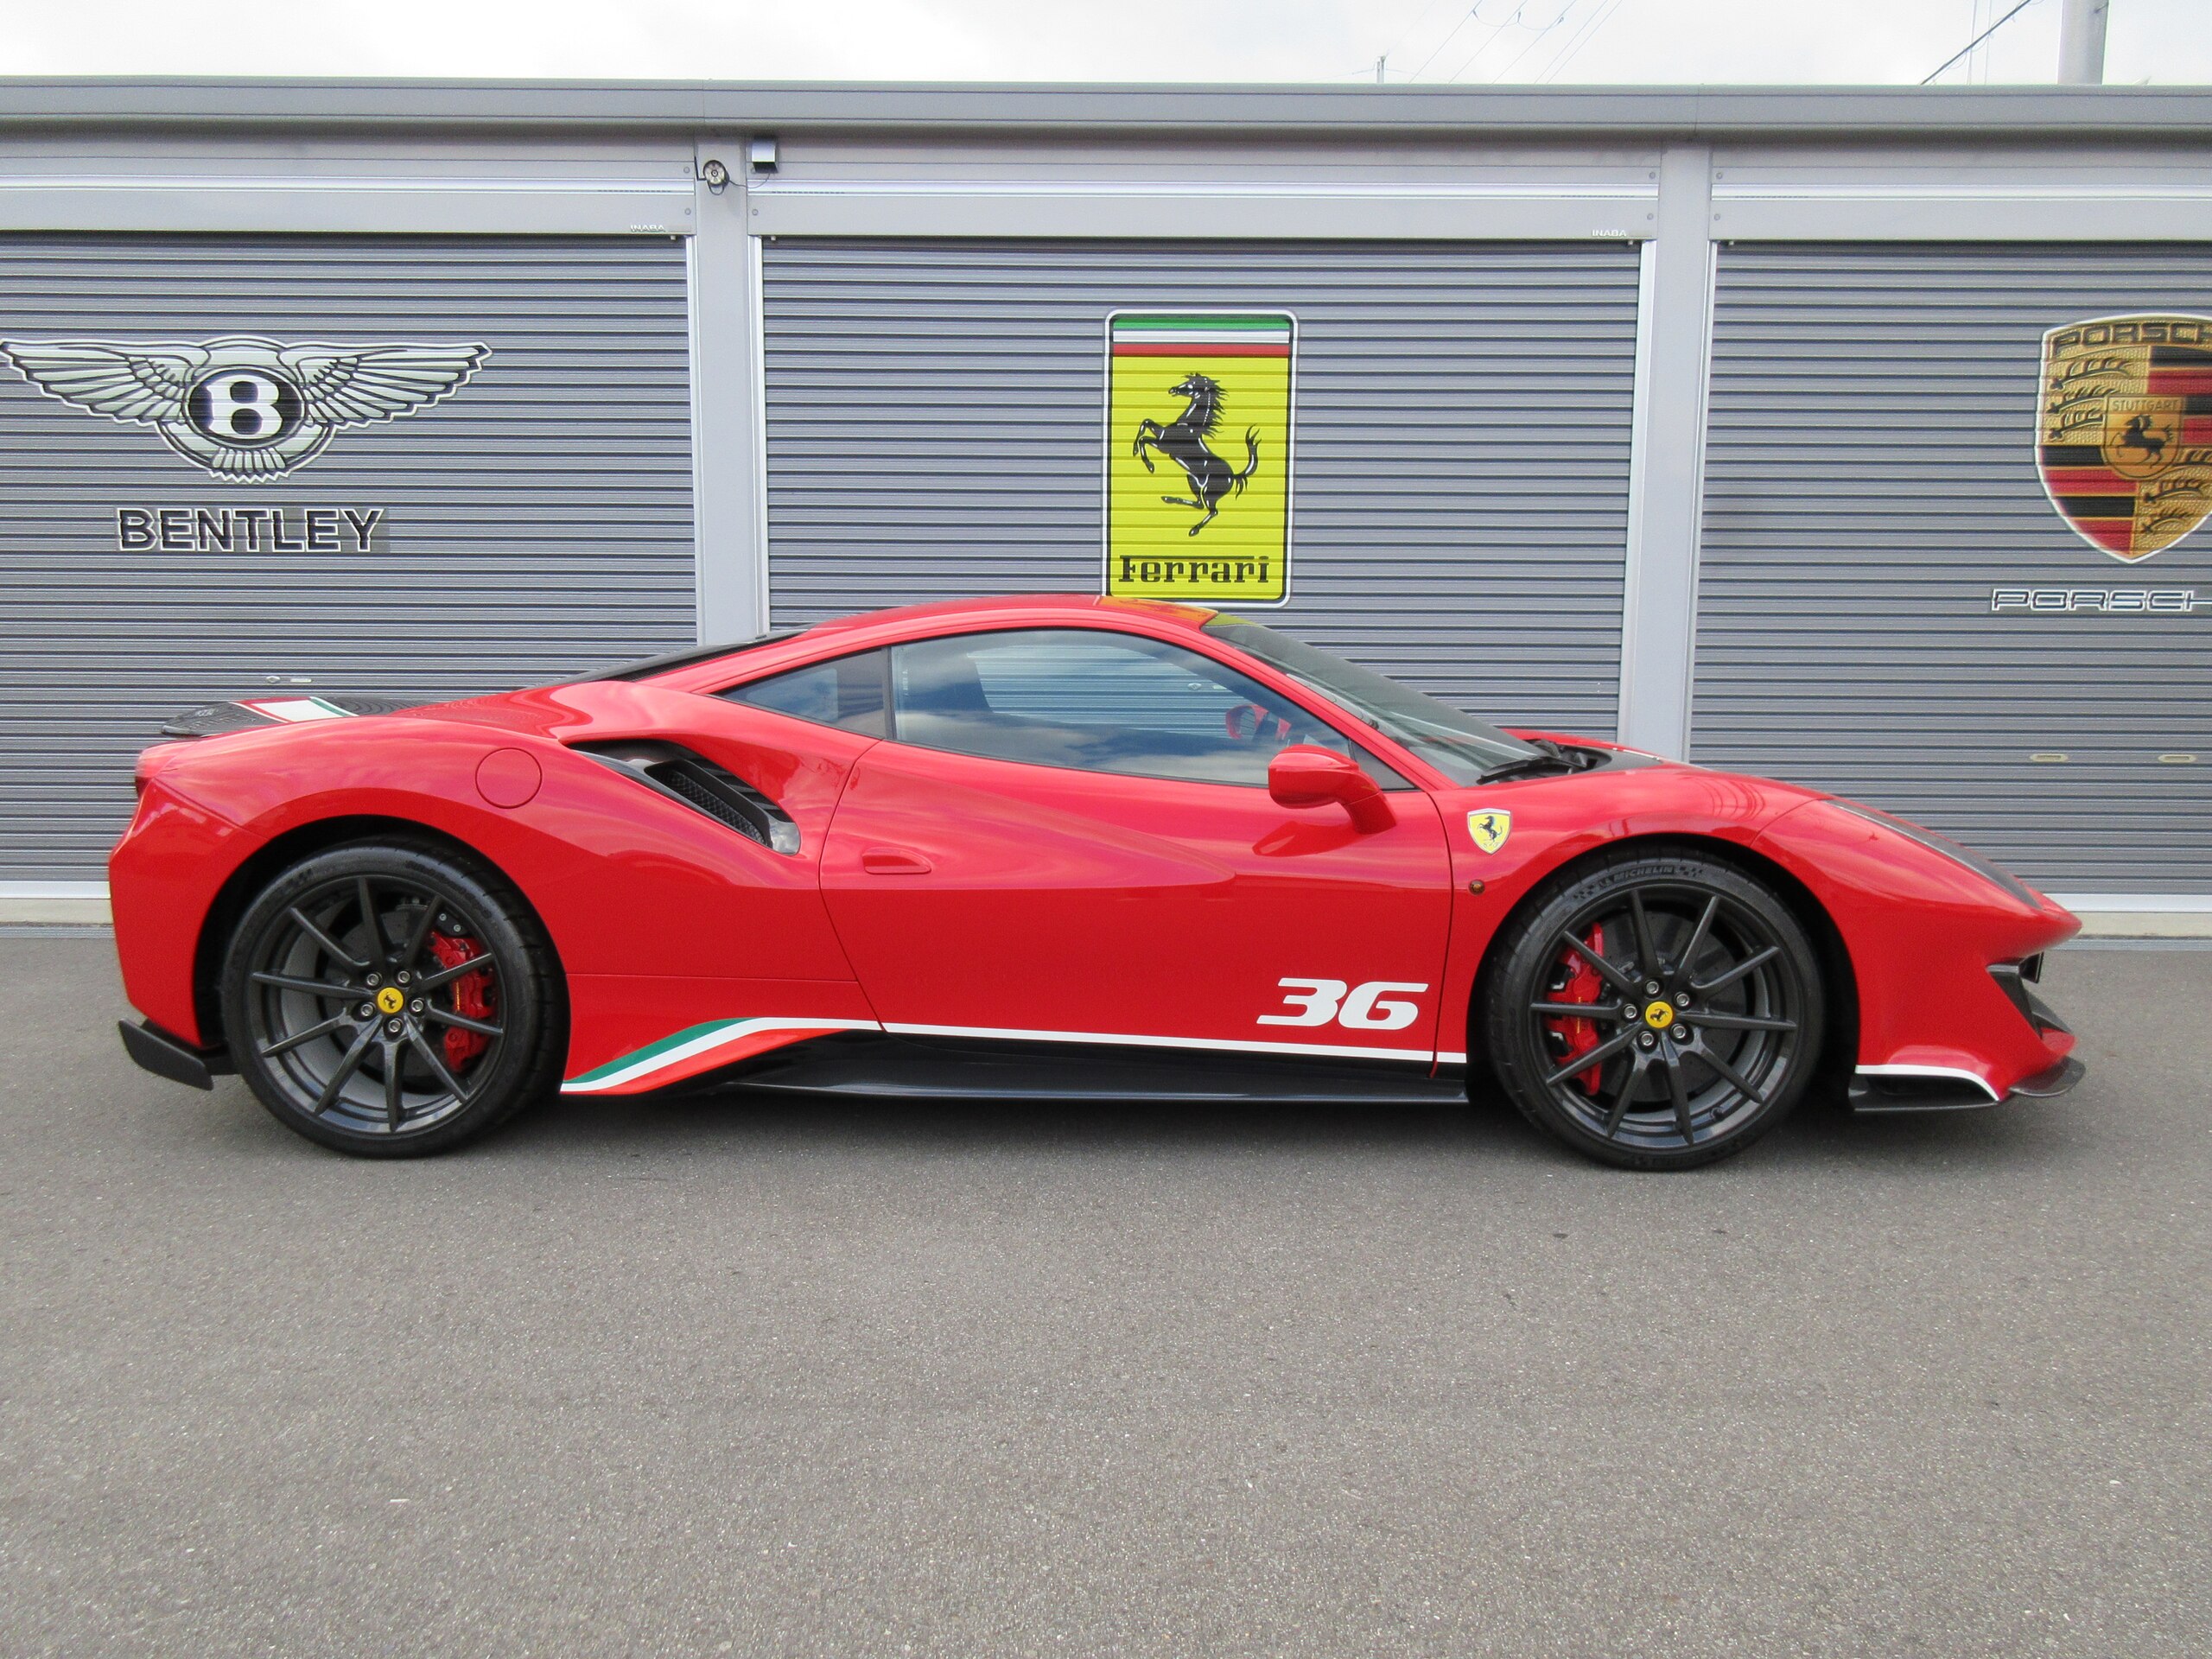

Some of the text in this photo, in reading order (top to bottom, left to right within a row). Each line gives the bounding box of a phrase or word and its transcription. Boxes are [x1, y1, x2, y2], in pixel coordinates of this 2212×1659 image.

[206, 374, 283, 439] B
[2113, 399, 2177, 411] STUTTGART
[118, 507, 385, 552] BENTLEY
[1118, 555, 1269, 583] Ferrari
[1613, 865, 1674, 882] MICHELIN
[1256, 977, 1428, 1031] 36
